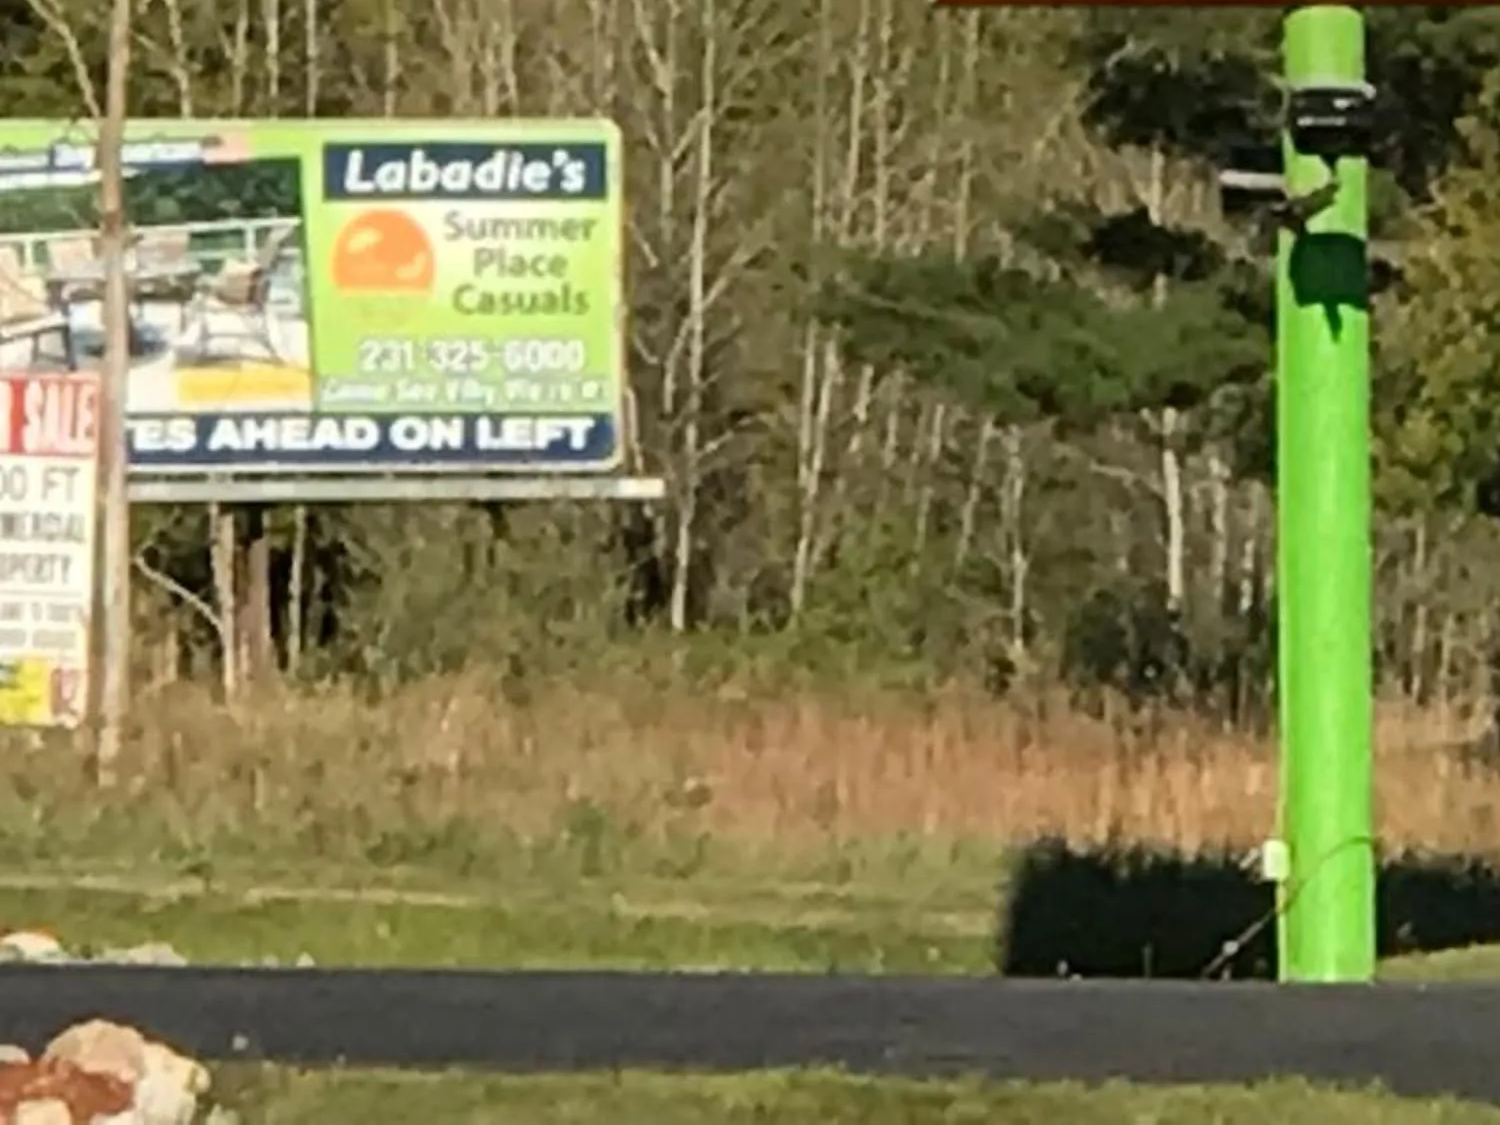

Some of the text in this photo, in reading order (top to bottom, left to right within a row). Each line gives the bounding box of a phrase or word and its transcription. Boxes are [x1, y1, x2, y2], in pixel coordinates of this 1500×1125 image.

[343, 148, 586, 193] Labadie's
[443, 210, 598, 242] Summer
[473, 247, 568, 277] Place
[452, 283, 591, 316] Casuals
[23, 379, 97, 453] SALE
[206, 417, 379, 451] AHEAD
[390, 416, 464, 451] ON
[476, 416, 595, 451] LEFT
[41, 465, 81, 503] FT
